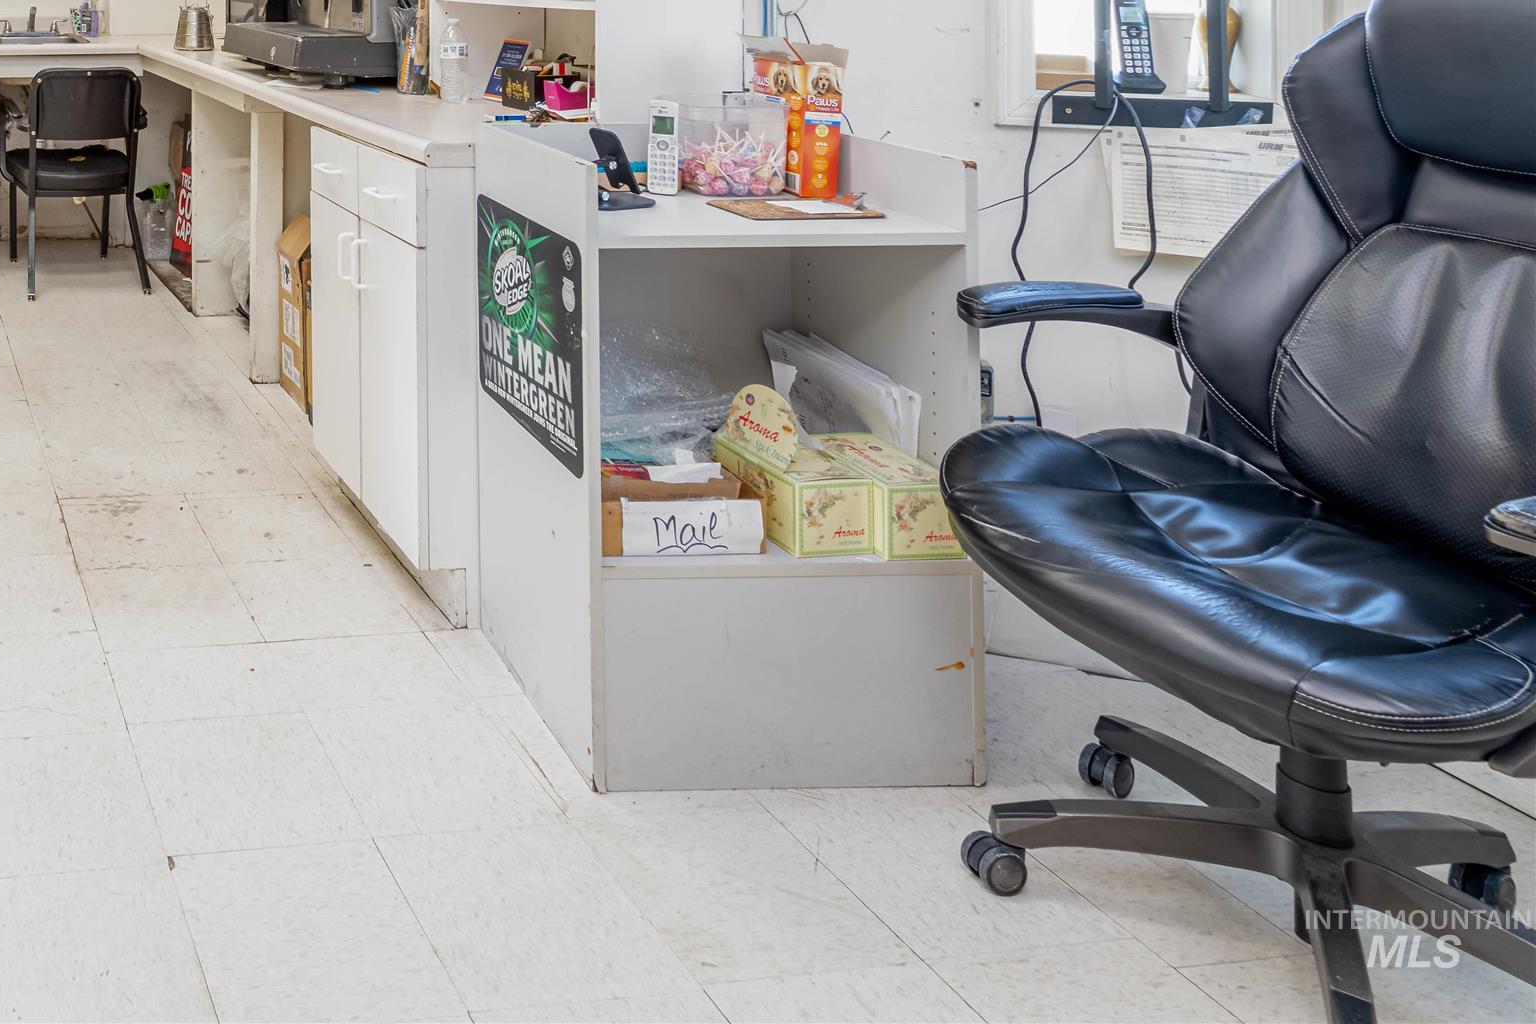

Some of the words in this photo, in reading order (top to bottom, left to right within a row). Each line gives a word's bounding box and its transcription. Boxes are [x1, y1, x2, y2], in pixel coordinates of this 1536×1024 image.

[807, 94, 838, 108] Paws
[494, 258, 530, 295] SKOAL
[507, 282, 528, 306] EDGE
[481, 314, 513, 366] ONE
[517, 334, 572, 405] MEAN
[482, 351, 575, 439] WINTERGREEN
[506, 392, 533, 419] WINTERGREEN
[546, 420, 555, 435] THE
[735, 410, 779, 444] Aroma
[652, 512, 723, 547] Mail
[832, 526, 865, 539] Aroma
